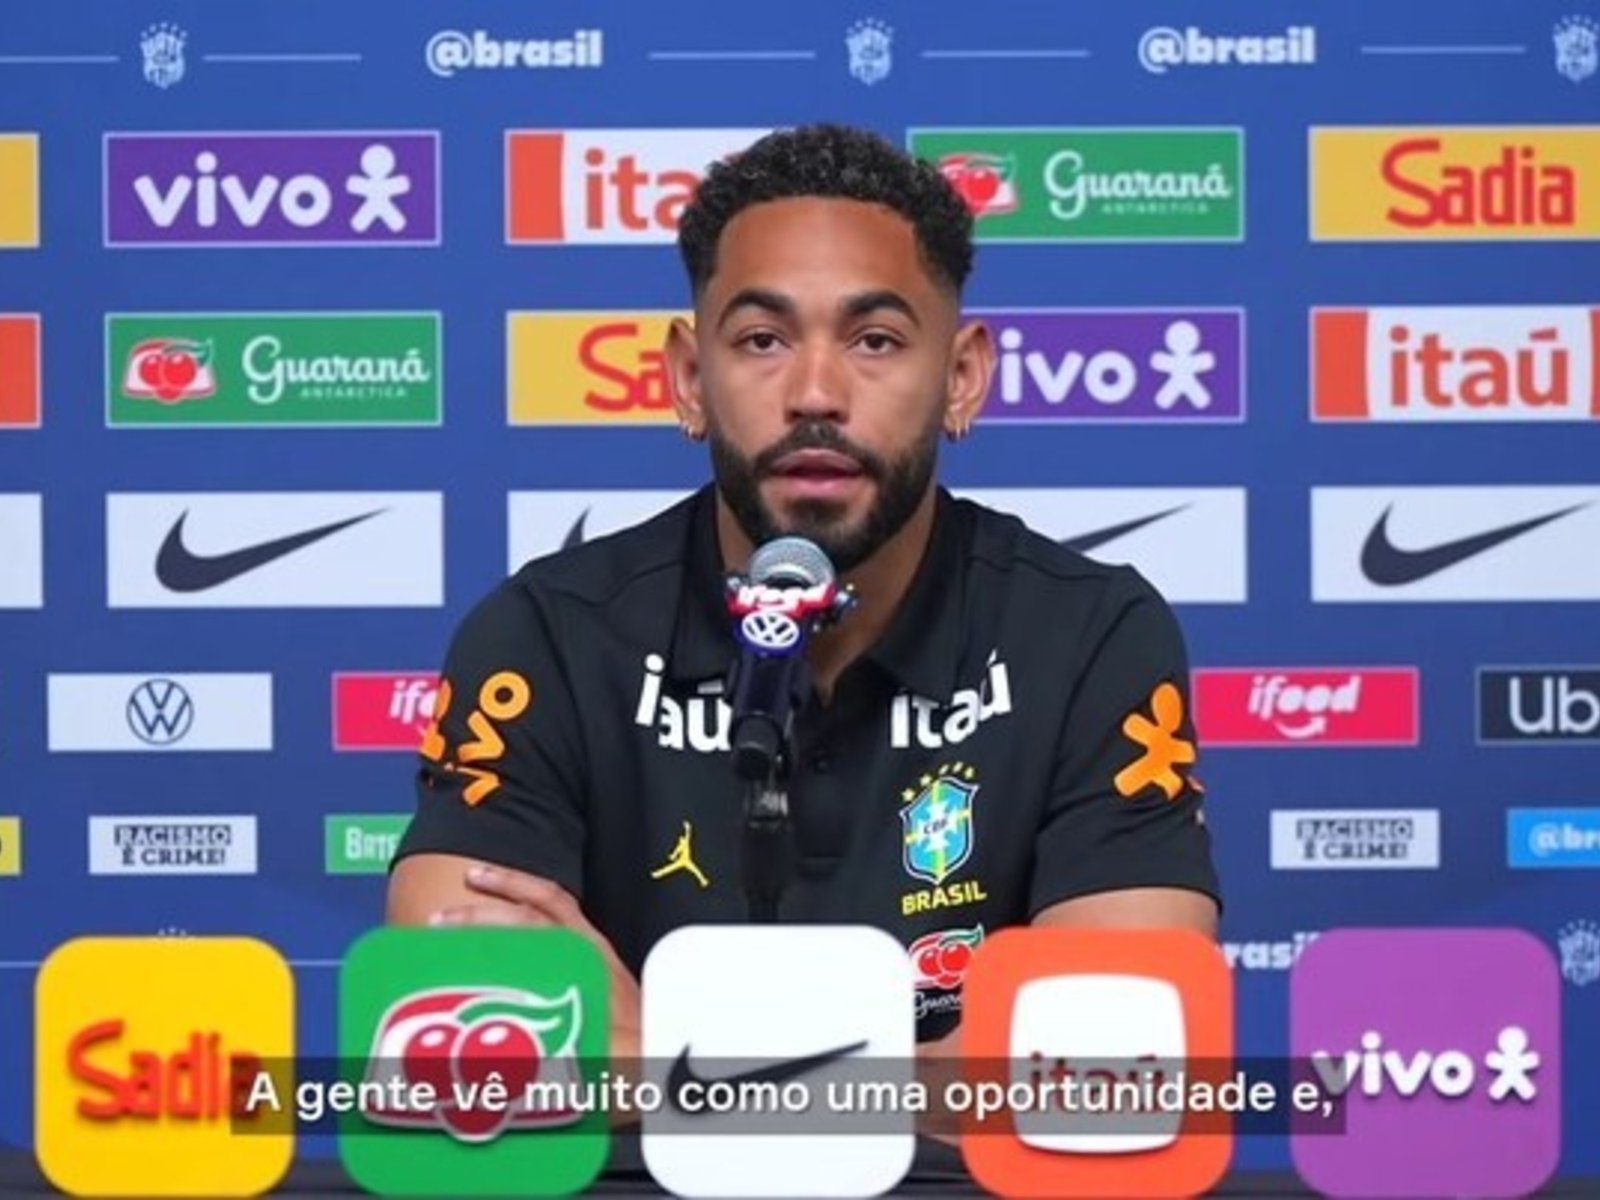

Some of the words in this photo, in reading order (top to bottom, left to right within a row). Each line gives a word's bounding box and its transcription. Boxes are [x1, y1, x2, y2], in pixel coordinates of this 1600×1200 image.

[426, 31, 603, 76] @brasil
[1138, 27, 1316, 73] @brasil
[134, 151, 332, 227] vivo
[585, 148, 701, 230] ita
[1043, 149, 1232, 220] Guaraná
[1381, 139, 1574, 228] Sadia
[242, 334, 431, 404] Guaraná
[1000, 328, 1136, 405] ivo
[1389, 325, 1568, 408] itaú
[1248, 675, 1362, 720] ifood
[1509, 677, 1600, 732] Ub
[117, 825, 231, 846] RACISMO
[903, 881, 988, 916] BRASIL
[67, 1018, 261, 1122] Sadia
[1311, 1031, 1475, 1096] vivo
